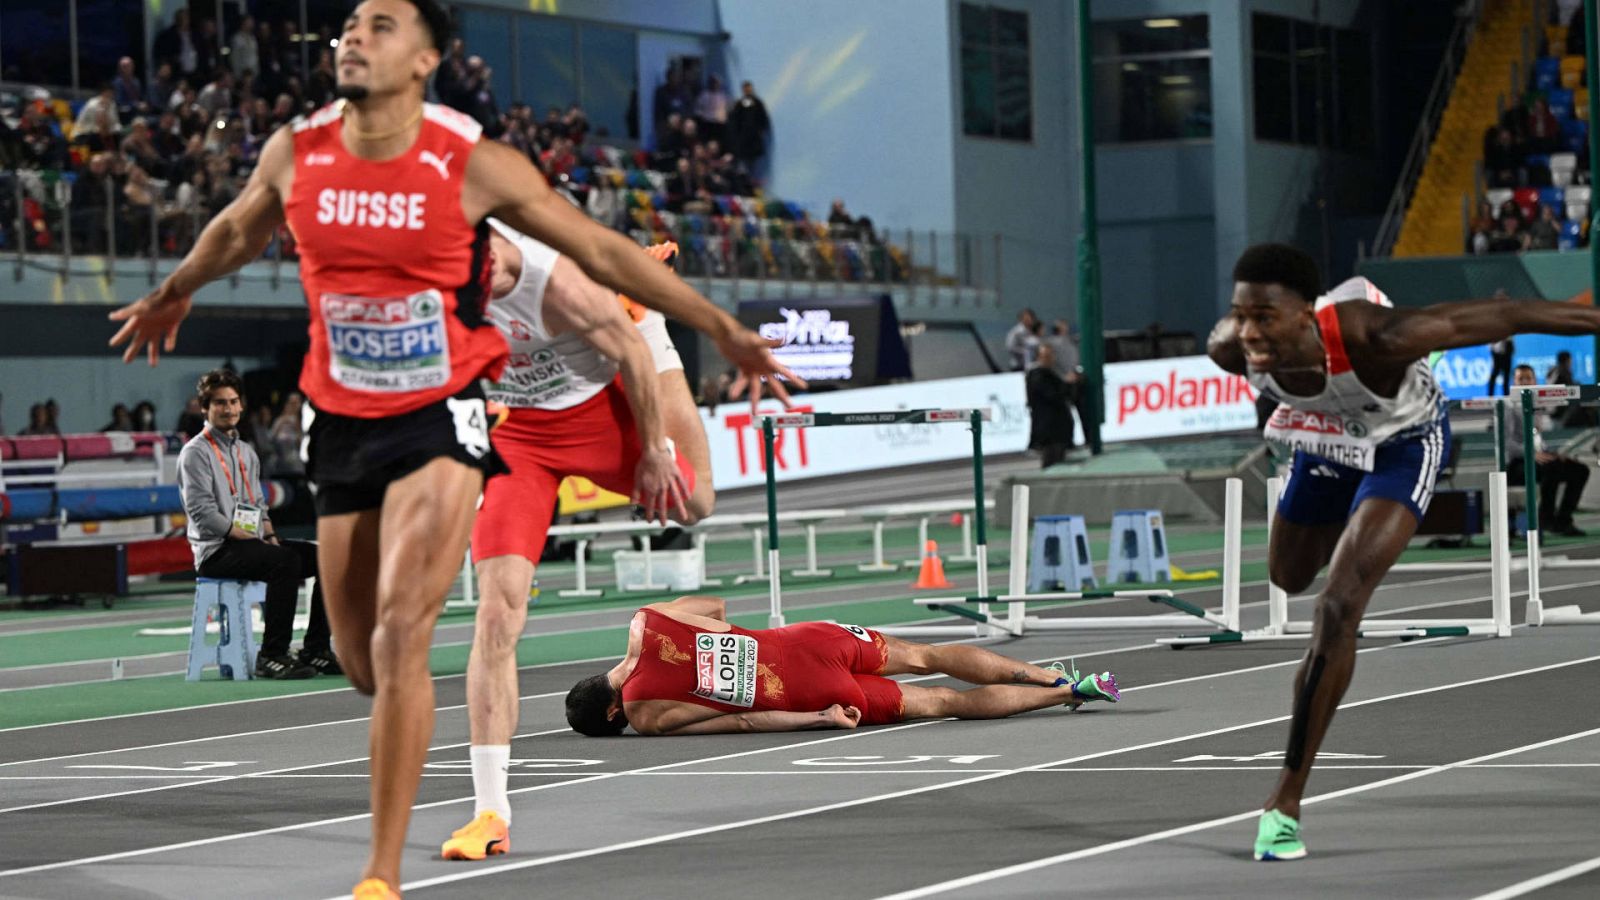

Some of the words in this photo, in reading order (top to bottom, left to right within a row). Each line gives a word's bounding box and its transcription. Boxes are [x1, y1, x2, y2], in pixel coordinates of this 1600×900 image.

[334, 323, 441, 357] JOSEPH
[1434, 355, 1490, 388] Ato
[1118, 370, 1256, 424] polanik
[725, 406, 814, 476] TRT
[1275, 410, 1342, 433] SPAR
[718, 637, 736, 702] LLOPIS
[747, 640, 756, 661] 2023
[698, 652, 712, 697] SPAR
[745, 663, 755, 704] ISTANBUL
